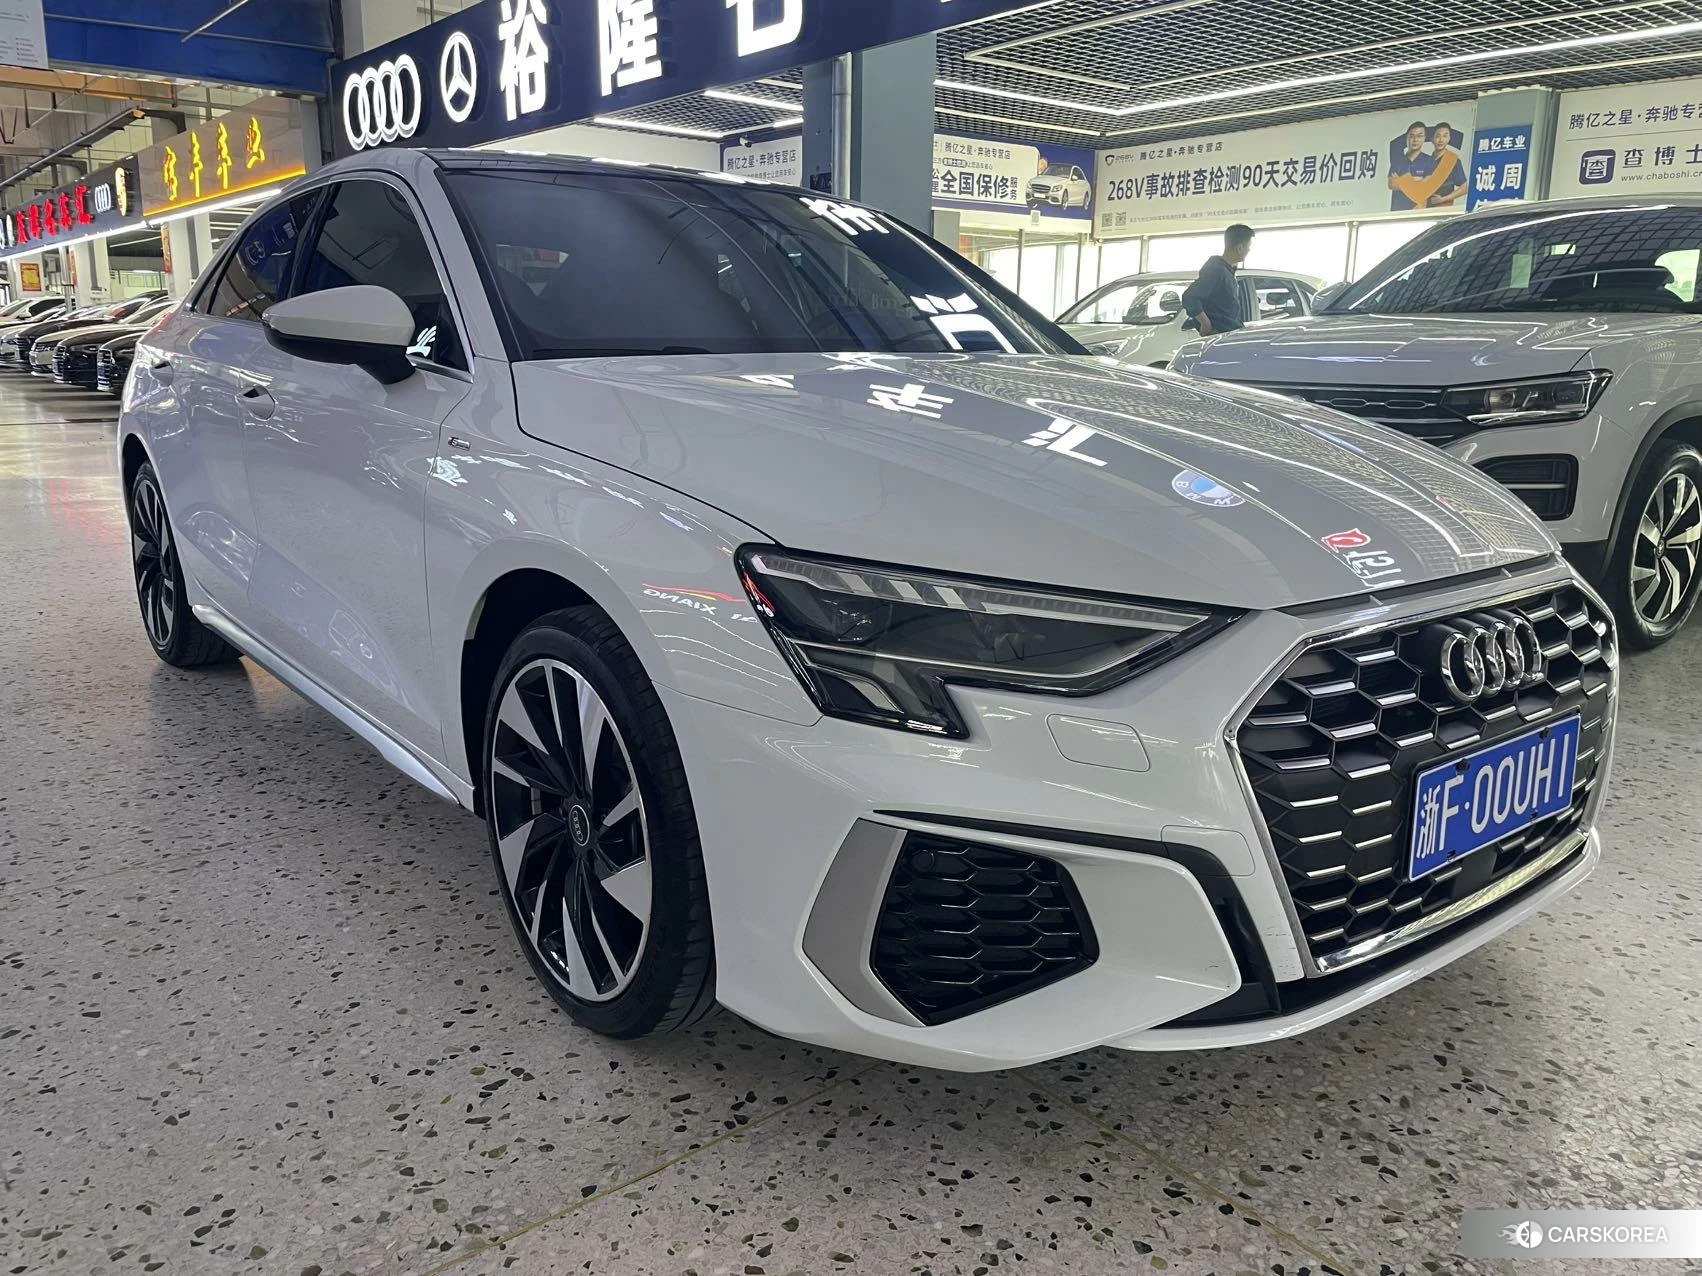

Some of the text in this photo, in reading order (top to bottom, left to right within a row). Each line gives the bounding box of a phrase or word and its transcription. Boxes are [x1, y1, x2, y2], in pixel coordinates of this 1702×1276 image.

[1568, 103, 1702, 130] 腾亿之星·奔驰专
[1622, 144, 1702, 169] 查博士
[940, 169, 1009, 199] 全国保修
[1107, 149, 1379, 201] 268V事故排查检测90天交易价回购
